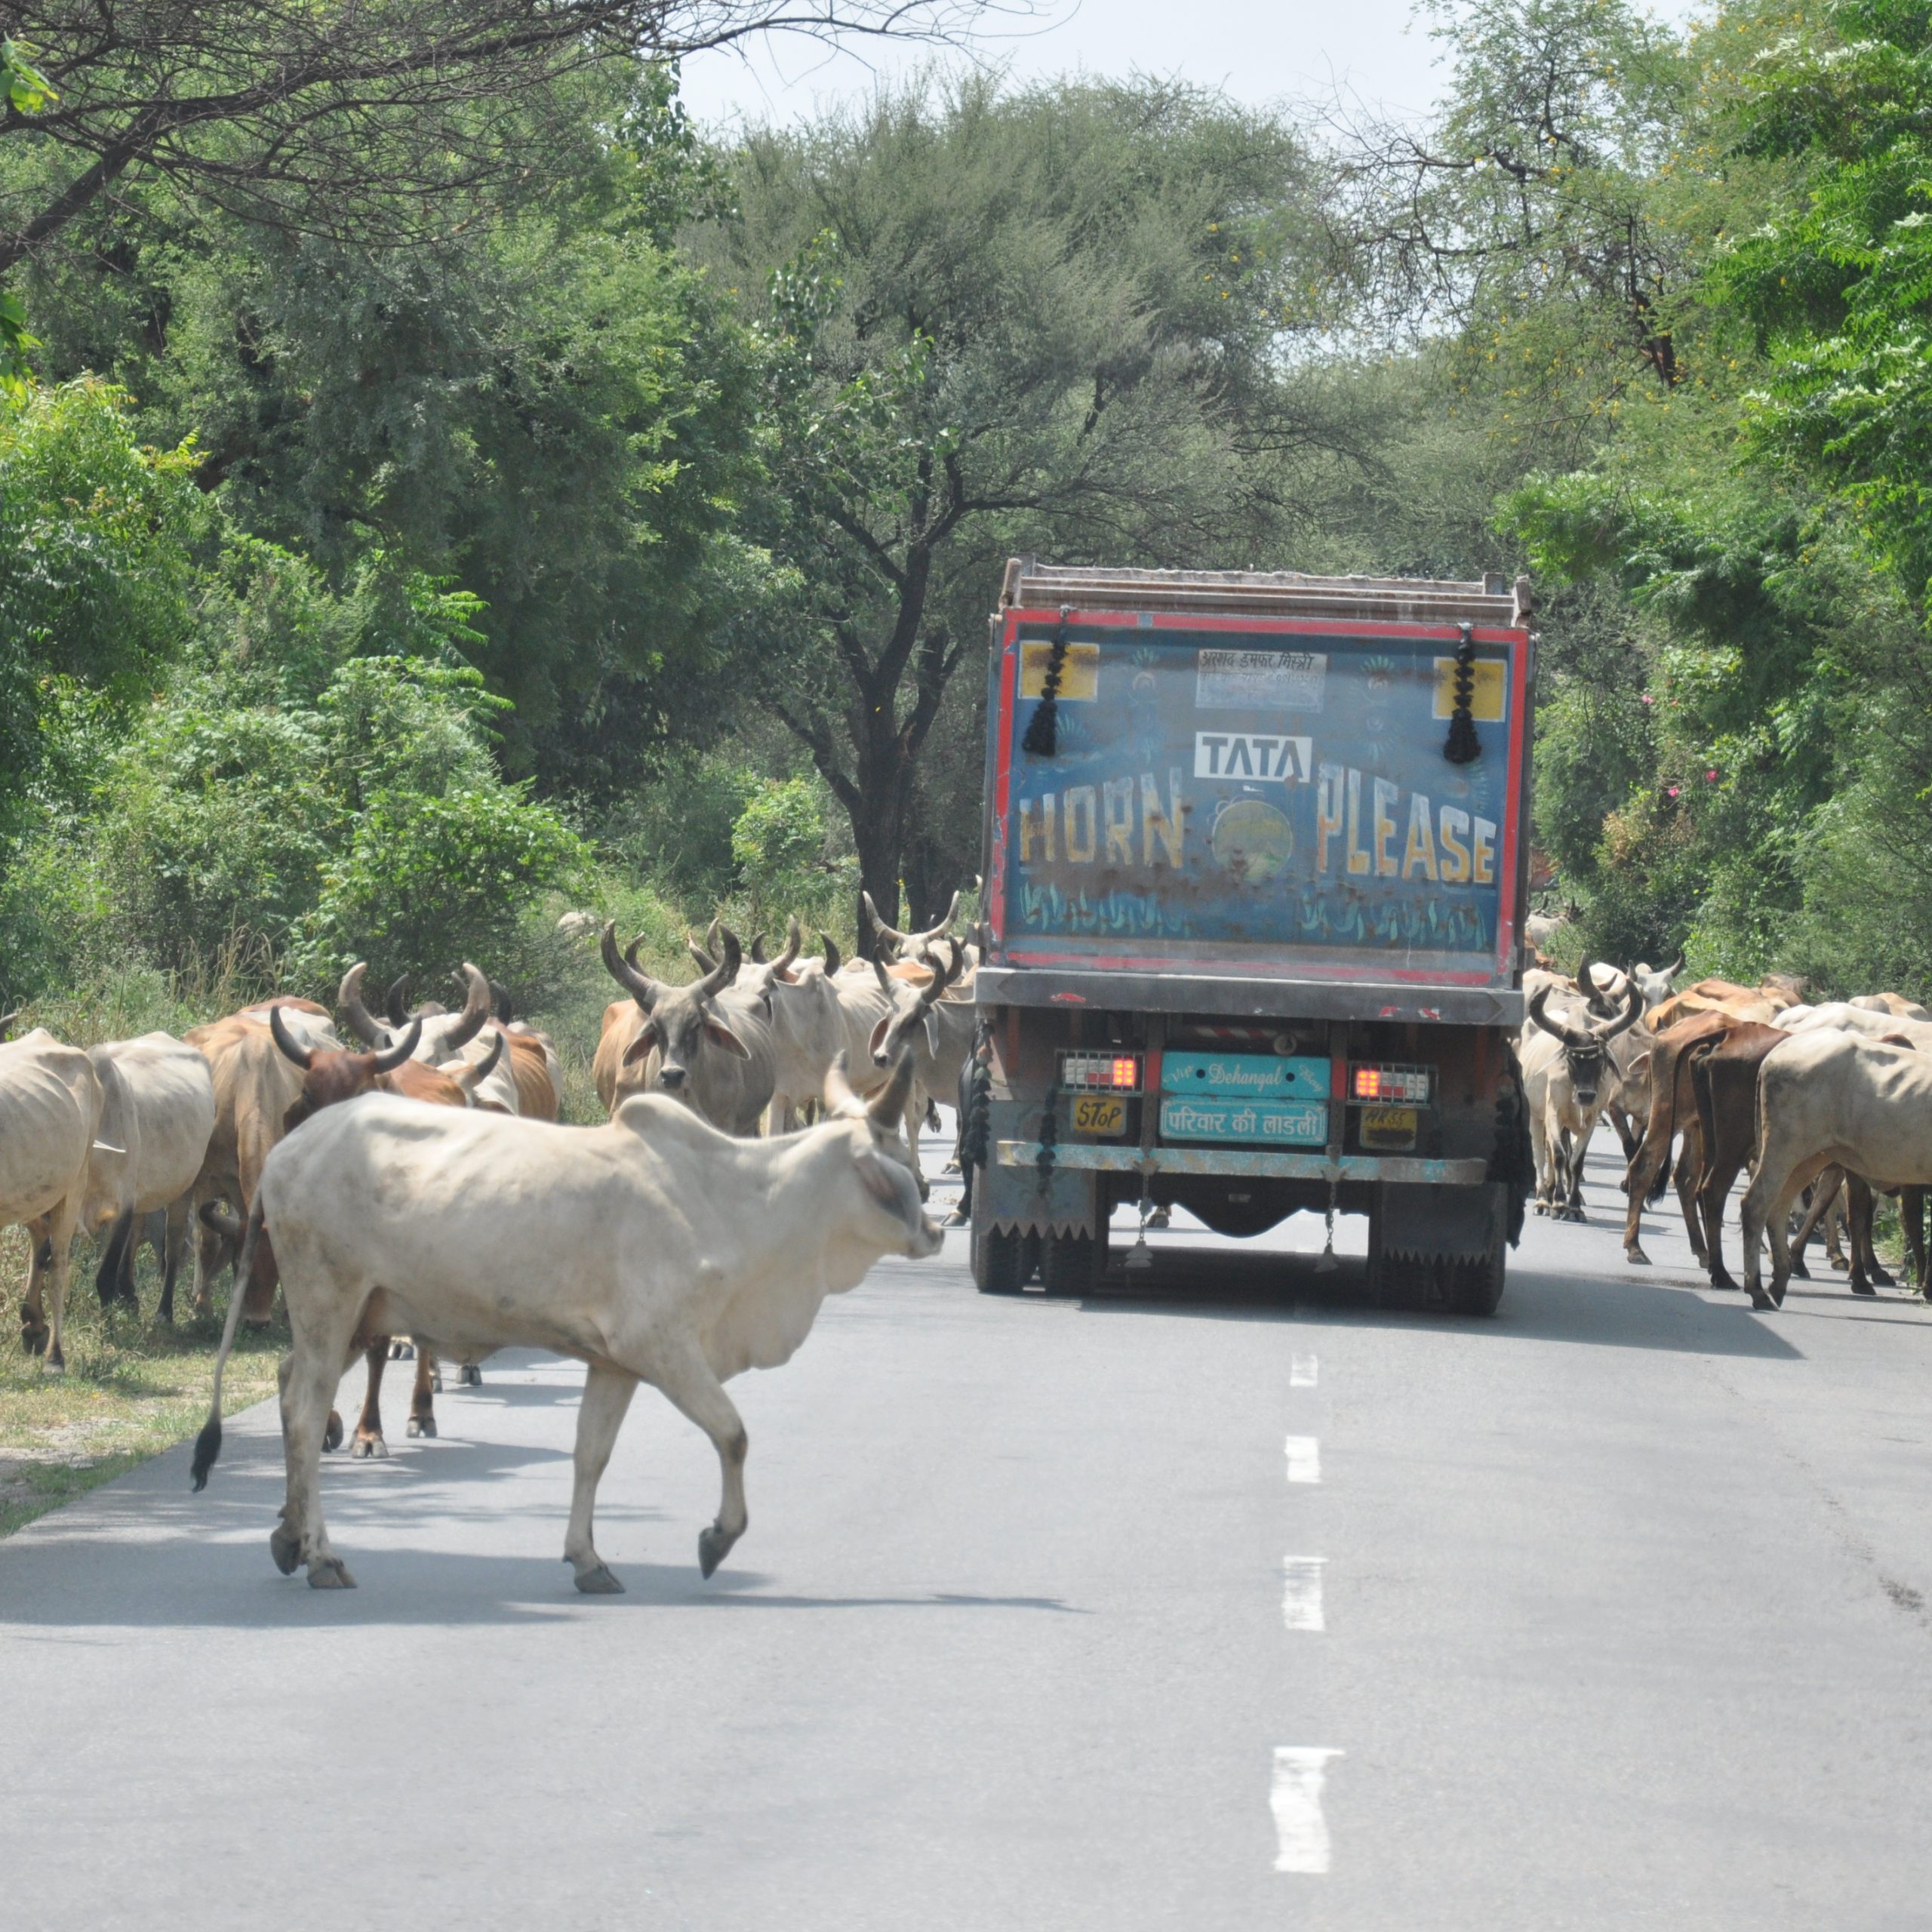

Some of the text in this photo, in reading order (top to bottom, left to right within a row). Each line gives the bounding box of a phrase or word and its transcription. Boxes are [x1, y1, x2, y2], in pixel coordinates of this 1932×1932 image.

[1202, 737, 1304, 778] TATA
[1020, 762, 1497, 884] HORN PLEASE
[1169, 1106, 1317, 1135] परिवार की लाडली
